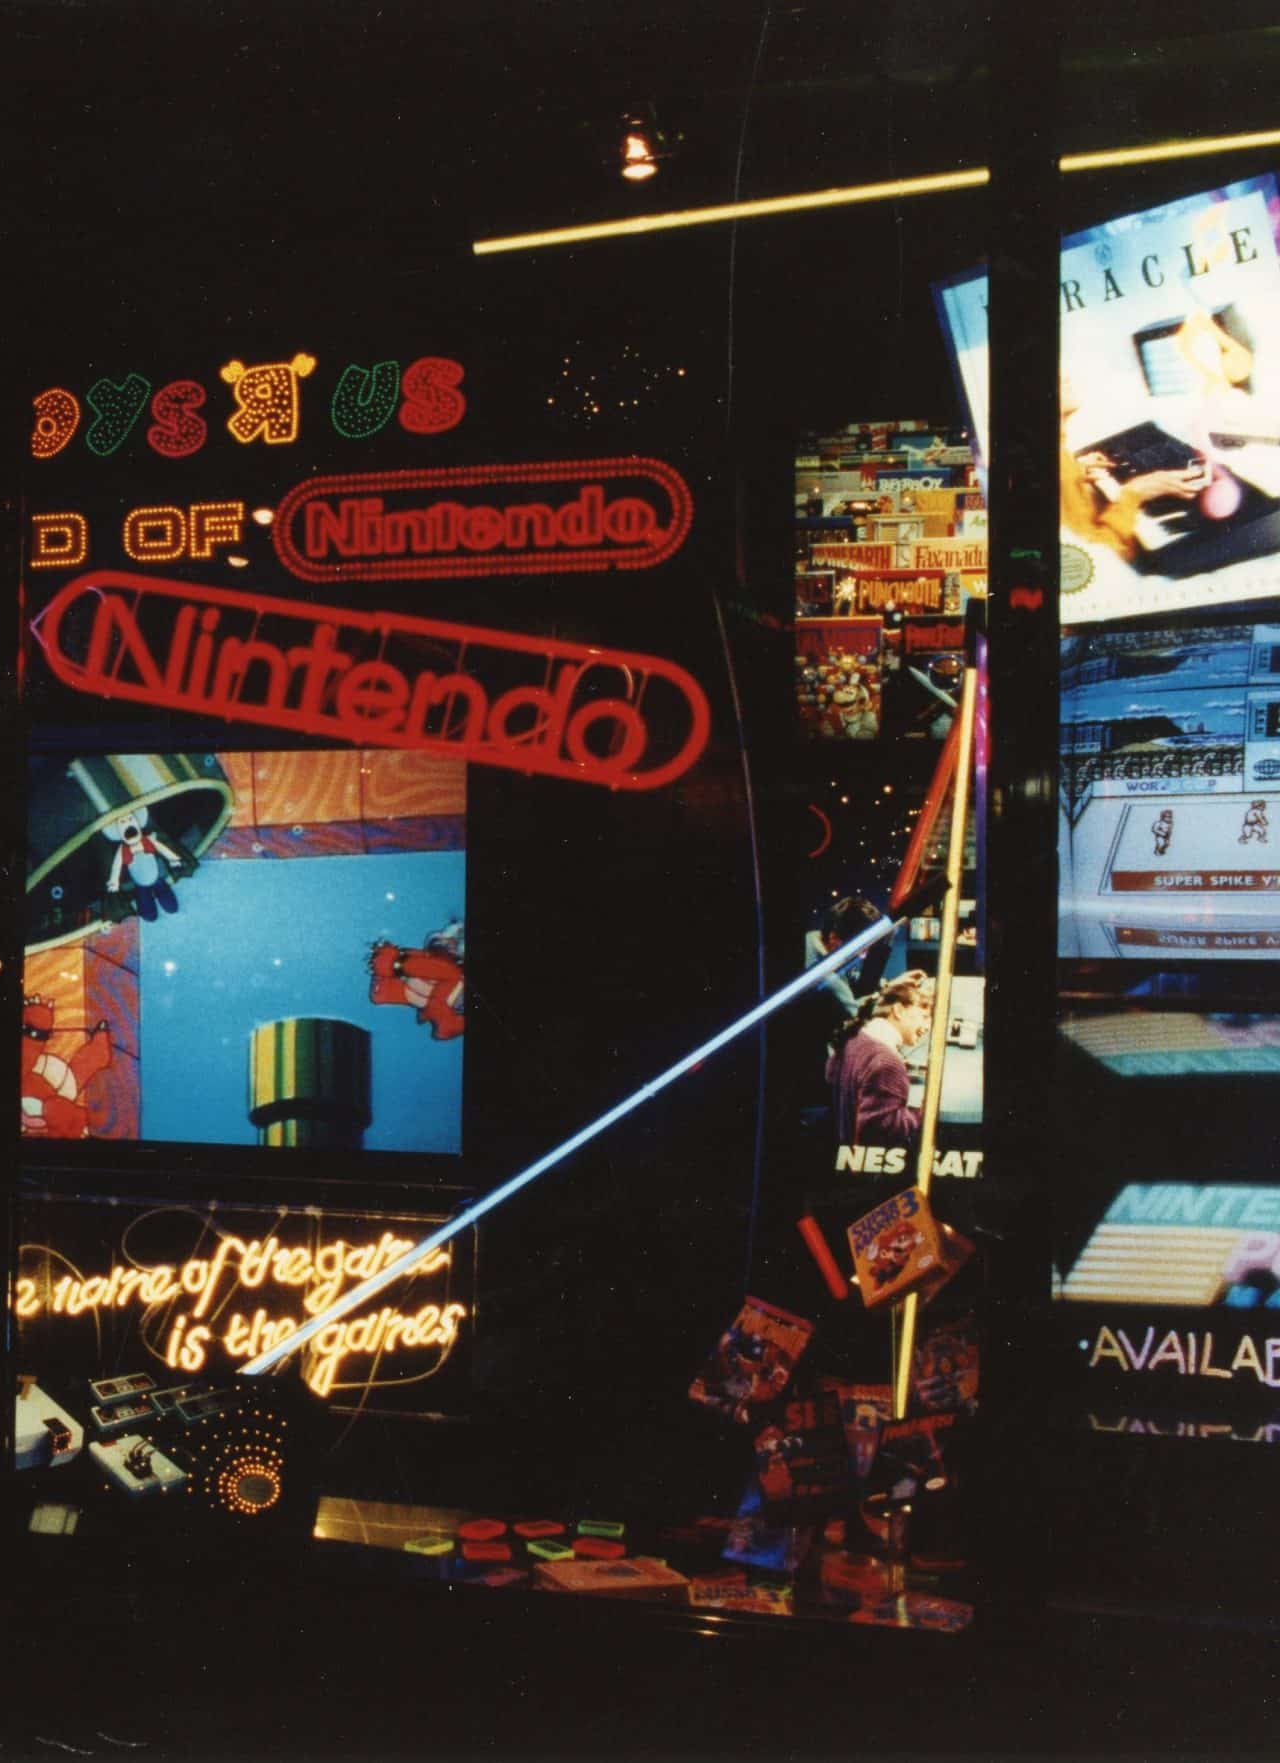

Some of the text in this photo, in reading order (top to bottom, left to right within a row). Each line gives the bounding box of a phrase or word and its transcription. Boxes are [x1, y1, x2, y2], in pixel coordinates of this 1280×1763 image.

[331, 356, 466, 438] US
[123, 502, 244, 561] OF
[306, 486, 660, 559] Nintendo
[82, 590, 650, 772] Nintendo
[1153, 875, 1204, 887] SUPER
[1209, 875, 1256, 887] SPIKE
[835, 1145, 907, 1174] NES
[52, 1265, 182, 1318] name
[182, 1235, 247, 1318] of
[239, 1236, 316, 1289] the
[305, 1231, 455, 1315] game
[166, 1302, 468, 1399] is the games
